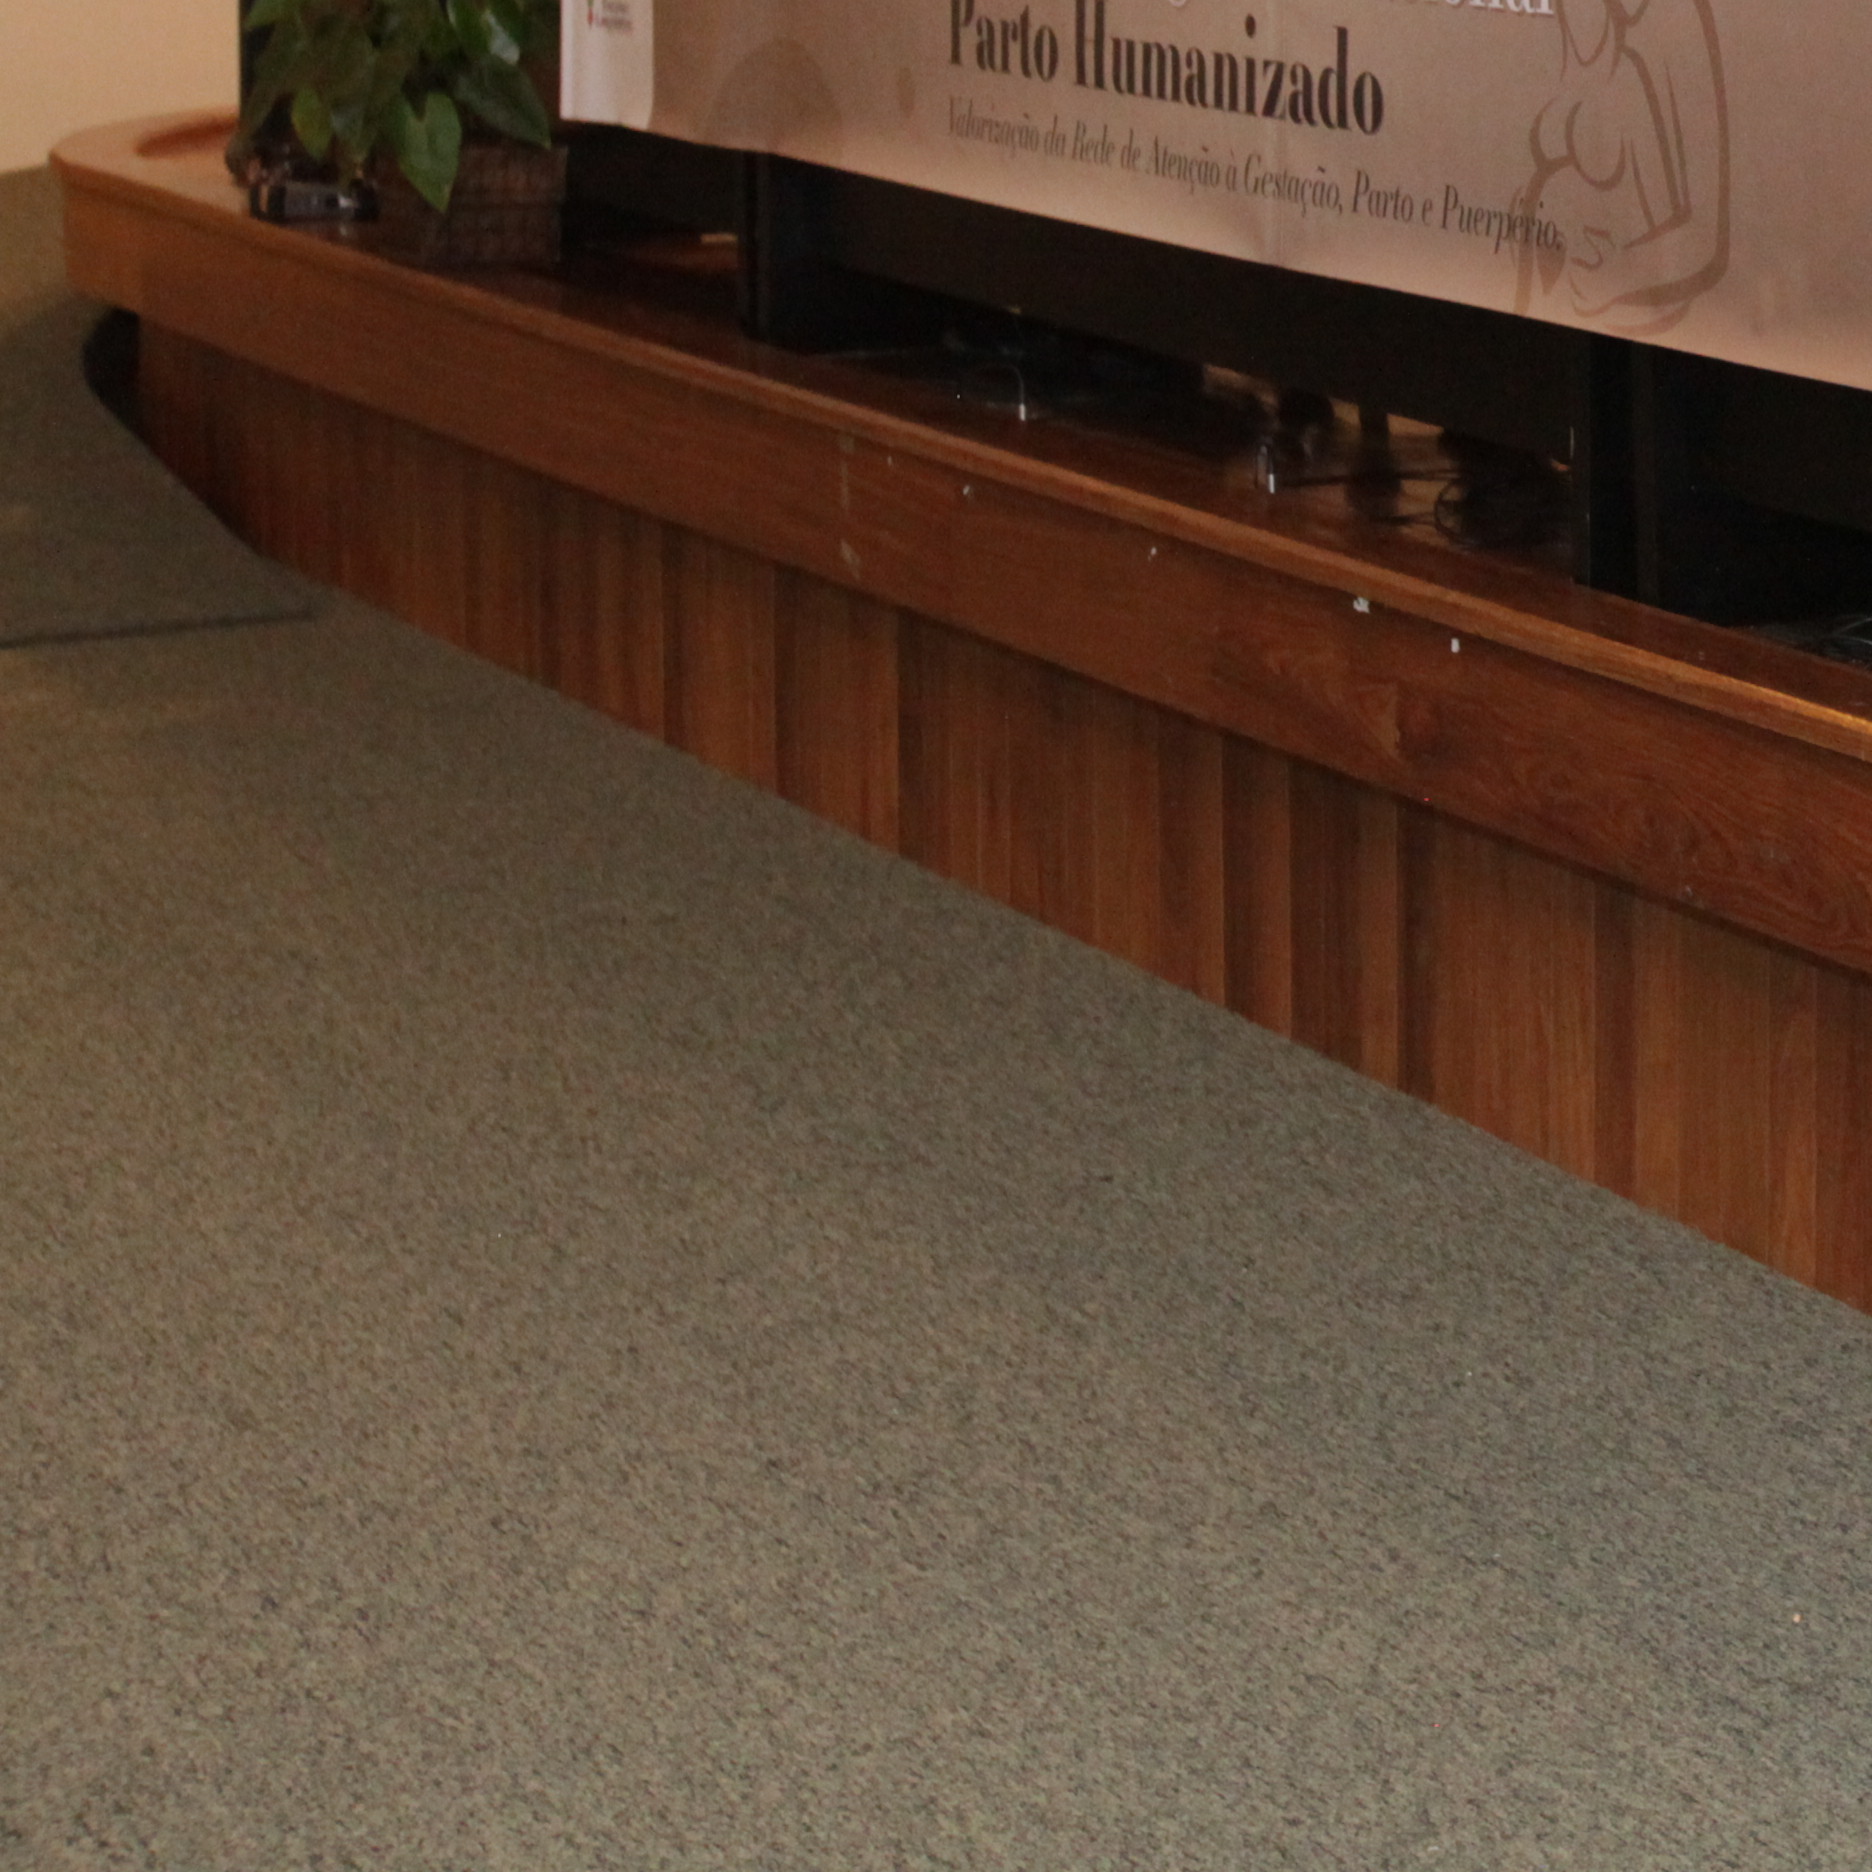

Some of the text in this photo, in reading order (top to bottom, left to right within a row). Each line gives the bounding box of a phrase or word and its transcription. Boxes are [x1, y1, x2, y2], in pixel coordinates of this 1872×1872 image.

[1043, 114, 1066, 157] da
[1072, 120, 1116, 166] Rede
[1120, 128, 1142, 171] de
[1147, 135, 1221, 194] Atenção
[1352, 168, 1414, 224] Parto
[1421, 198, 1434, 226] e
